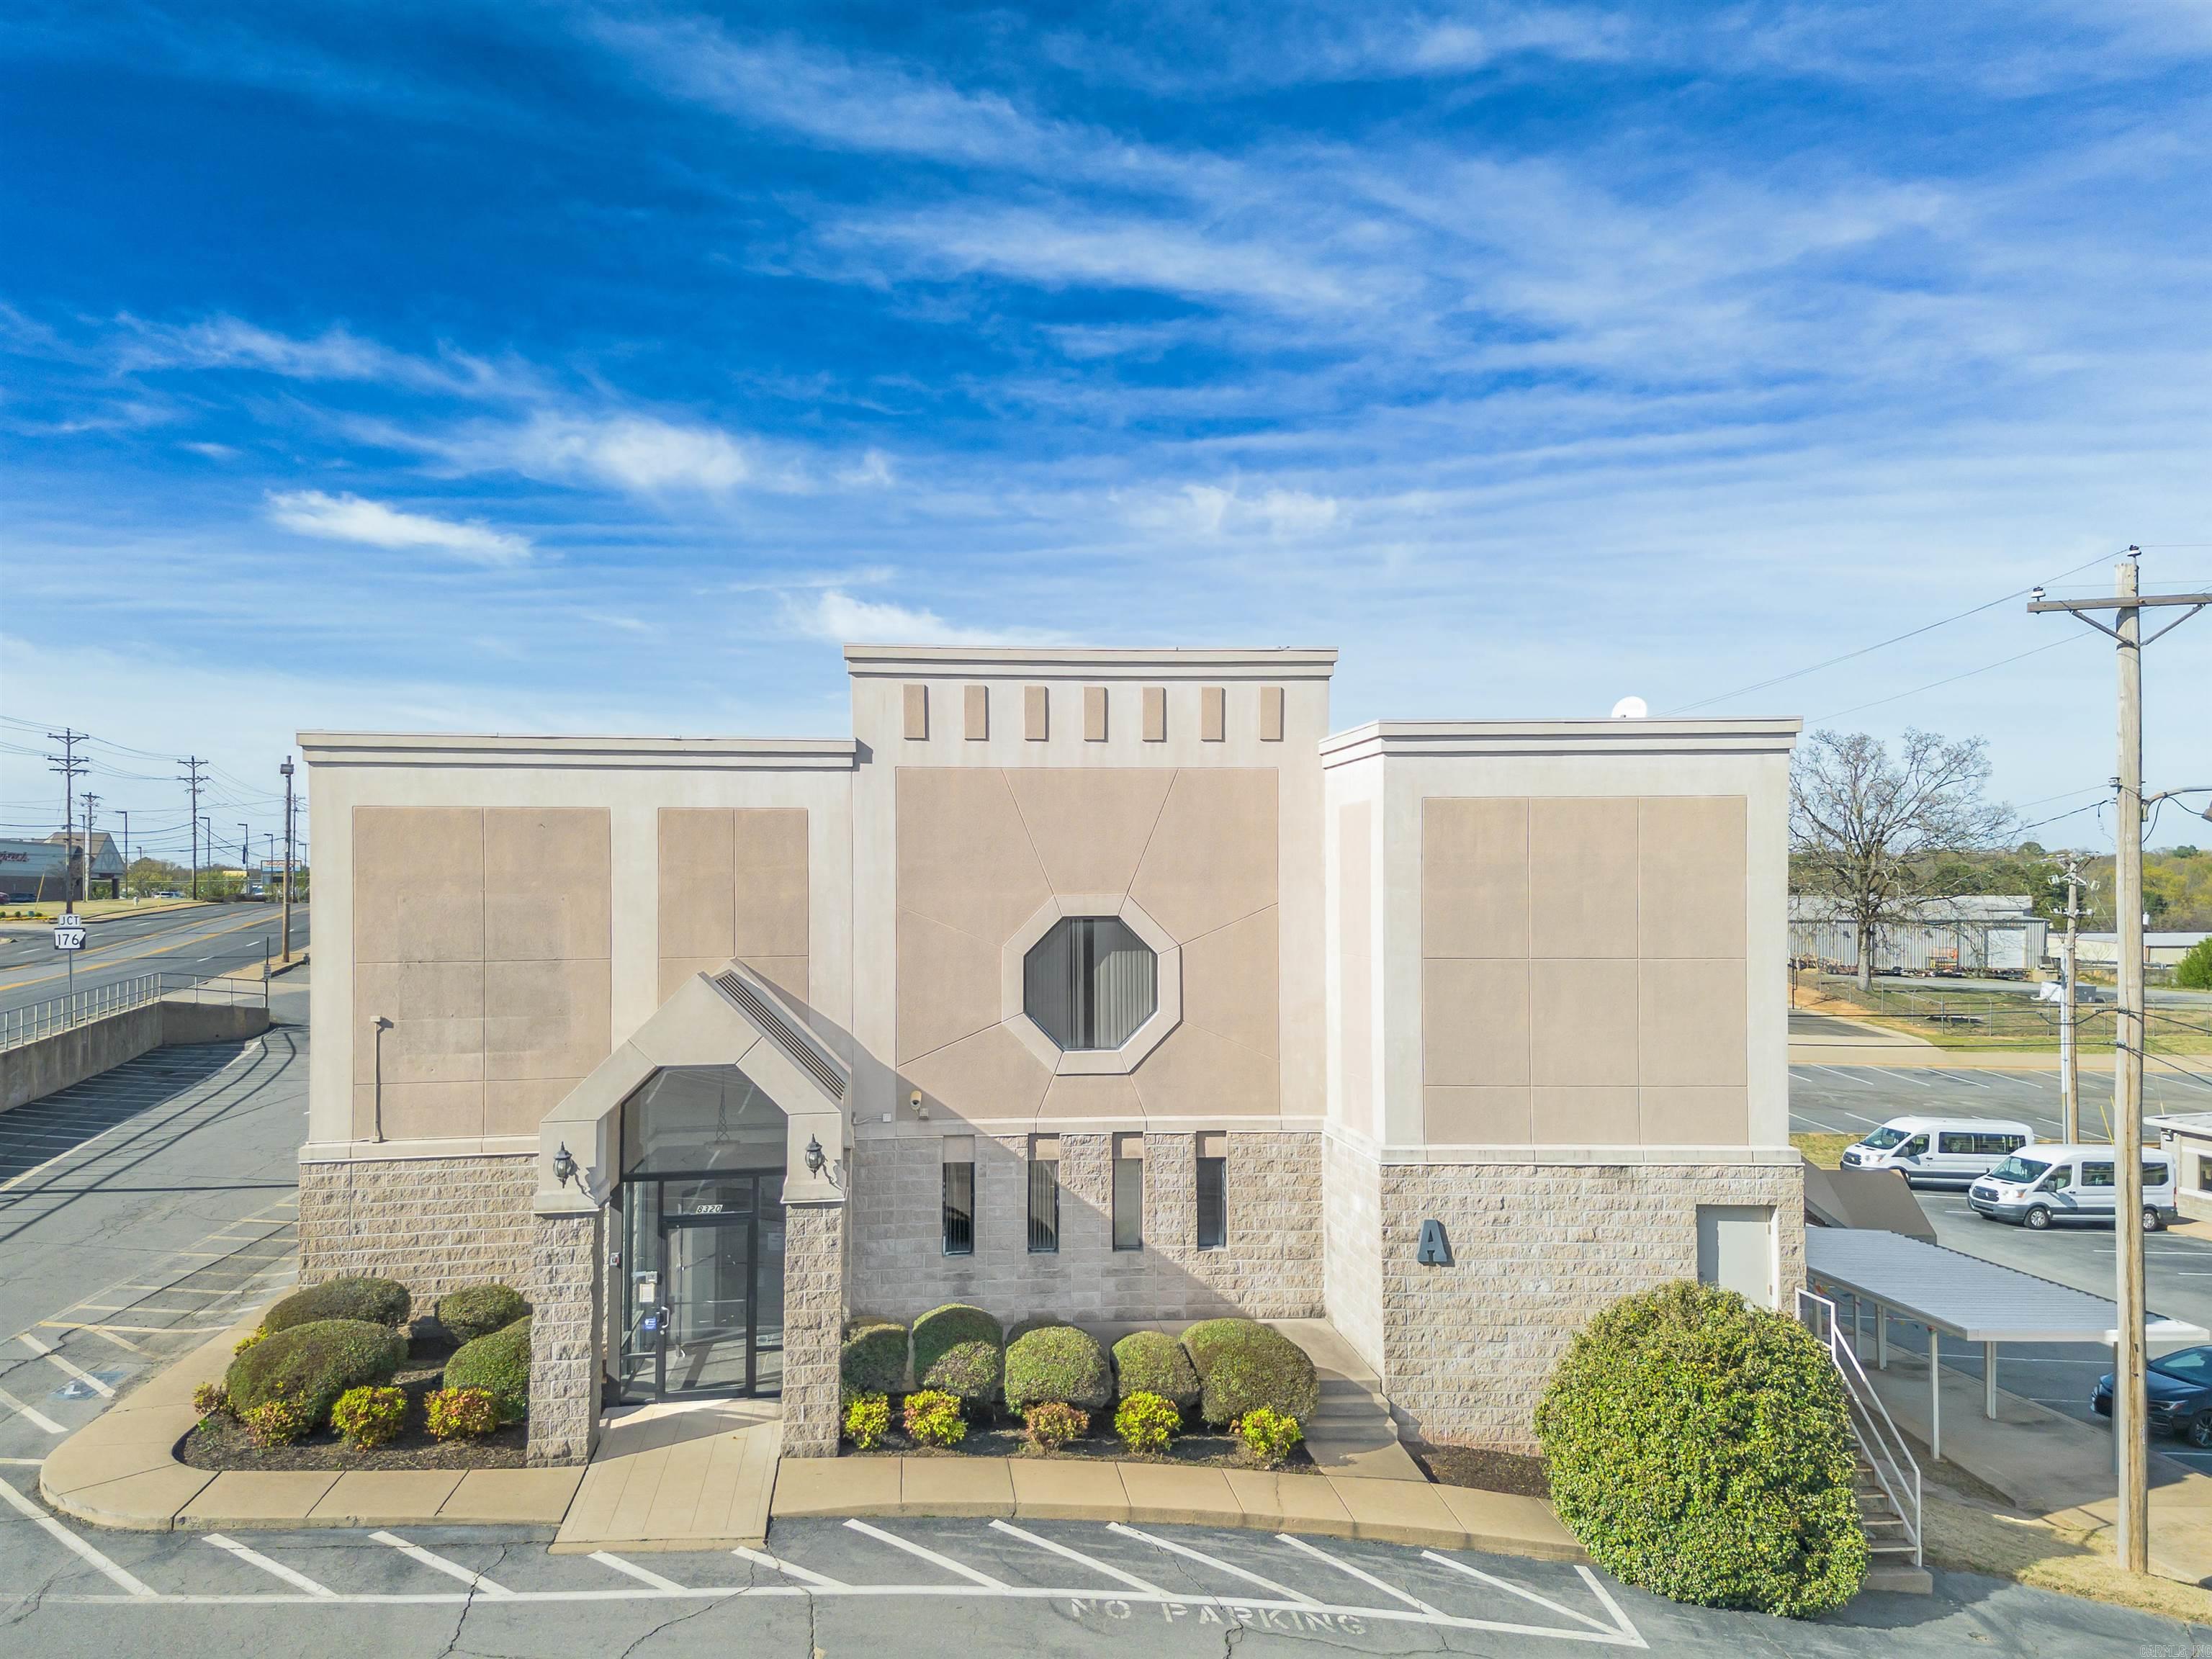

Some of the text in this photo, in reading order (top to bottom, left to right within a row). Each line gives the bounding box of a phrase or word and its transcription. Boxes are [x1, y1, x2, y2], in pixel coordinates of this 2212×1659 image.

[60, 915, 80, 925] JCT
[58, 933, 80, 945] 176
[697, 1205, 721, 1213] 8320
[1416, 1218, 1449, 1263] A
[1071, 1598, 1367, 1635] NO PARKING
